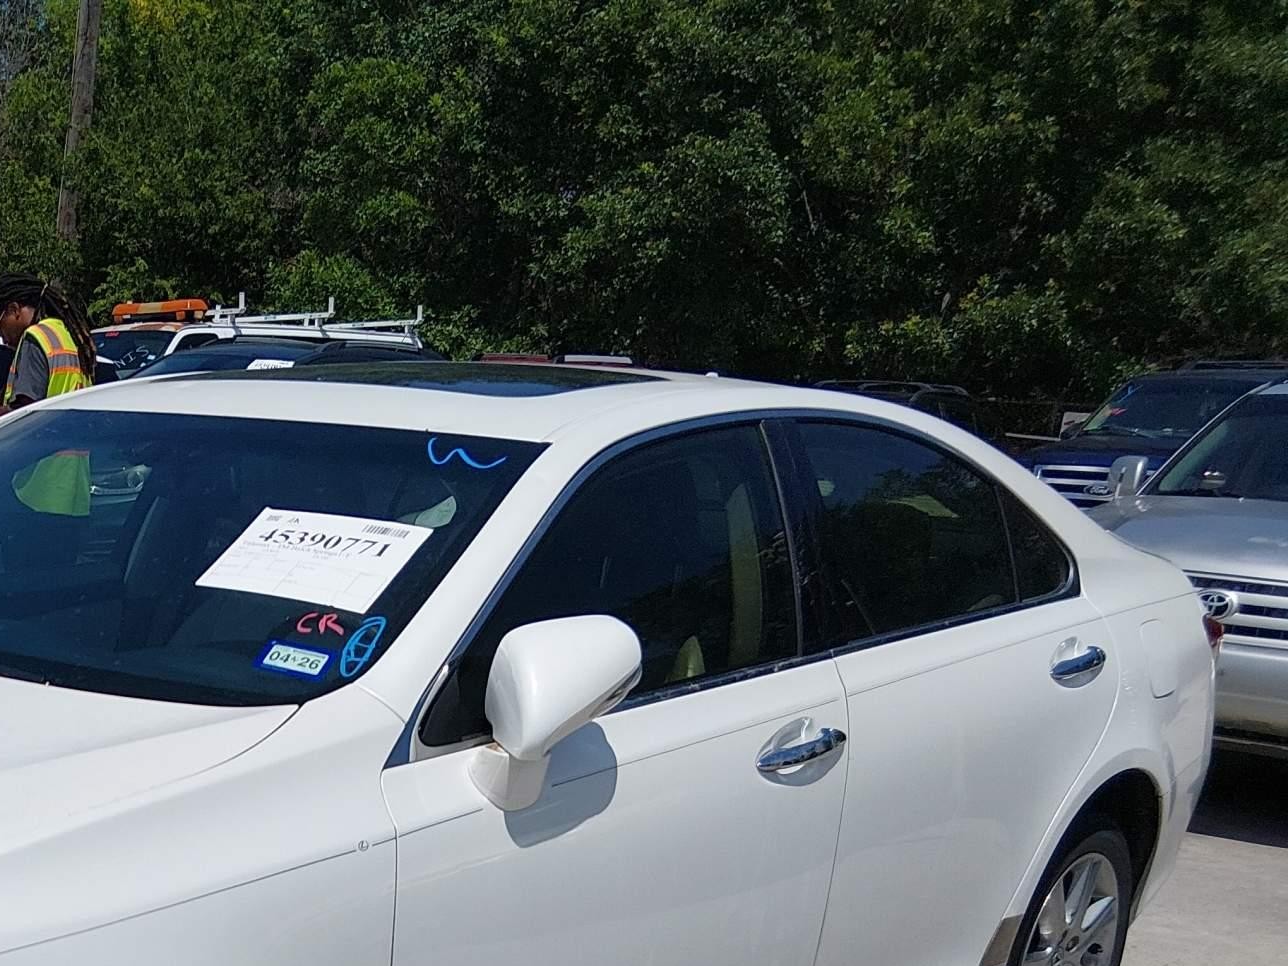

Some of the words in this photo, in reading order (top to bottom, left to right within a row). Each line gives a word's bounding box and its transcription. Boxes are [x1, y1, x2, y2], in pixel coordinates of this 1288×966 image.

[259, 527, 392, 558] 45390771
[268, 650, 291, 663] 04
[297, 656, 321, 670] 26
